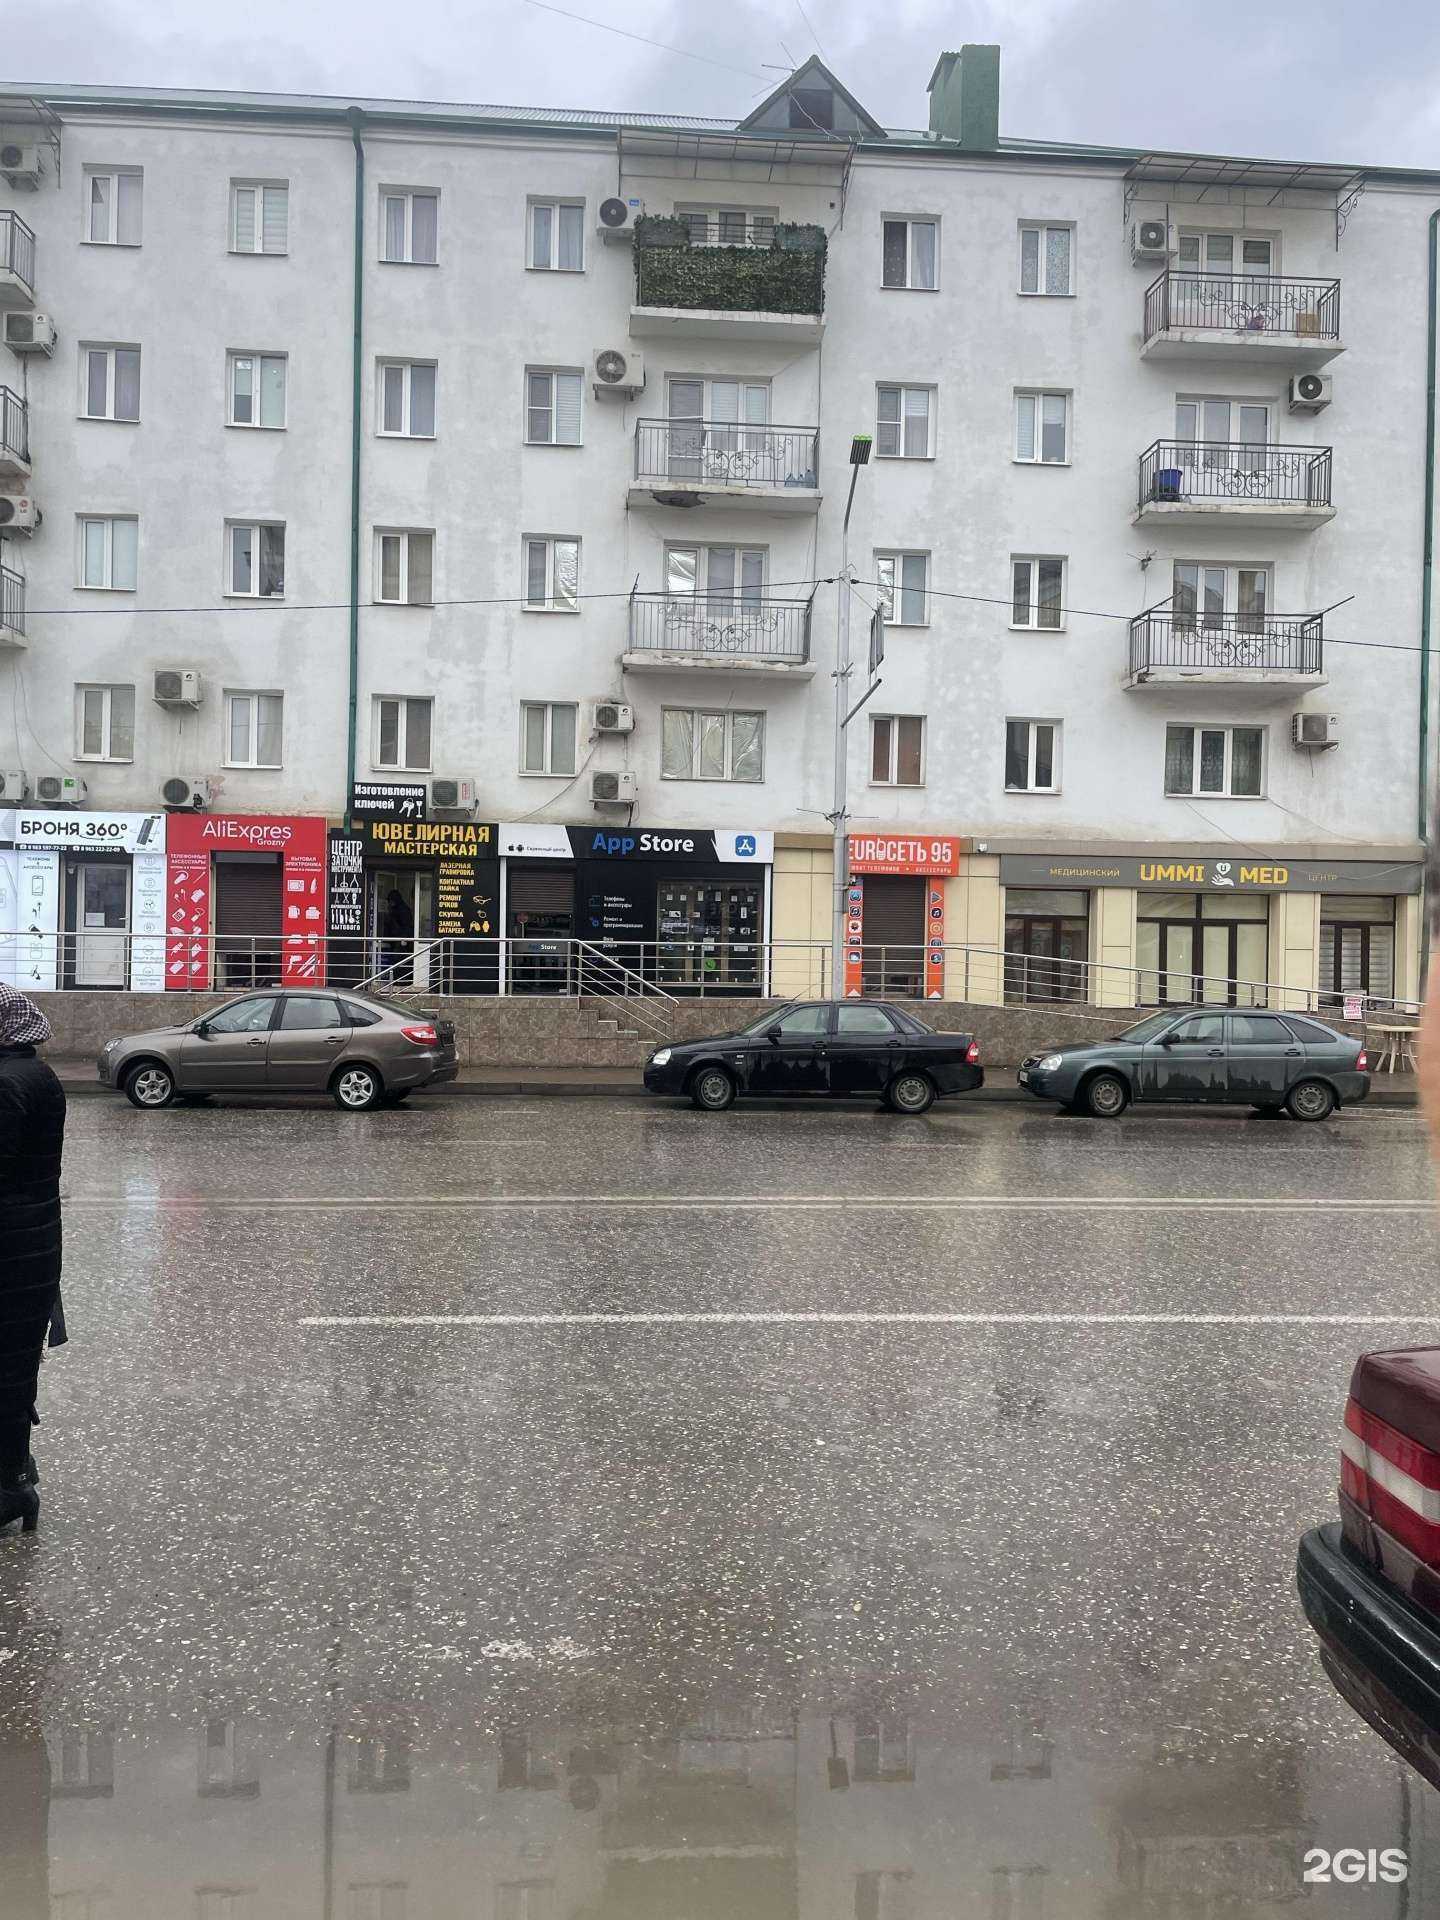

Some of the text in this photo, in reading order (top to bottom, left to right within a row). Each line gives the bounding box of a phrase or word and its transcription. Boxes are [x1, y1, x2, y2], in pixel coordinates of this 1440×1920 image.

[354, 784, 424, 796] Изготовление
[354, 798, 394, 809] ключей
[21, 821, 80, 836] БРОНЯ
[202, 820, 292, 843] AliExpres
[372, 822, 490, 843] ЮВЕЛИРНАЯ
[257, 838, 286, 847] Grozny
[331, 840, 363, 857] ЦЕНТР
[384, 841, 478, 856] МАСТЕРСКАЯ
[592, 833, 695, 855] App Store
[331, 855, 363, 866] ЗАТОЧКИ
[931, 842, 952, 863] 95
[1050, 867, 1120, 878] МЕДИЦИНСКИЙ
[1139, 863, 1204, 882] UMMI
[1240, 867, 1289, 884] MED
